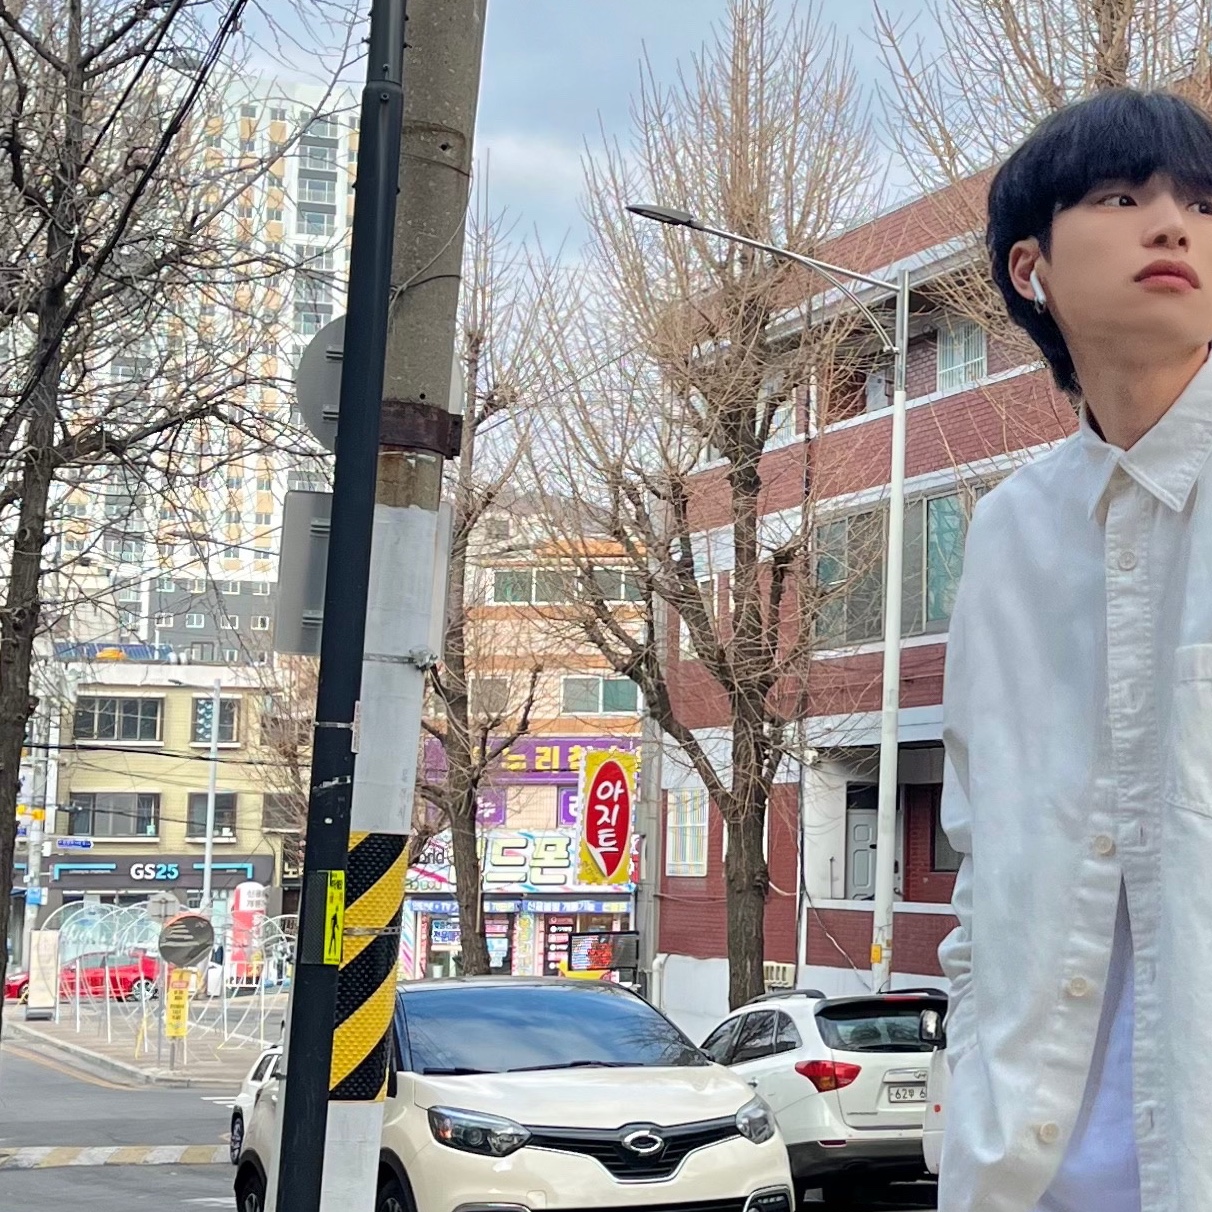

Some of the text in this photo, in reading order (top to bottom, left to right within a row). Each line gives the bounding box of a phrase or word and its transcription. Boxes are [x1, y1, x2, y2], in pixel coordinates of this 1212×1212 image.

[594, 780, 625, 853] 아지트
[129, 863, 180, 881] GS25
[478, 836, 571, 886] 드폰
